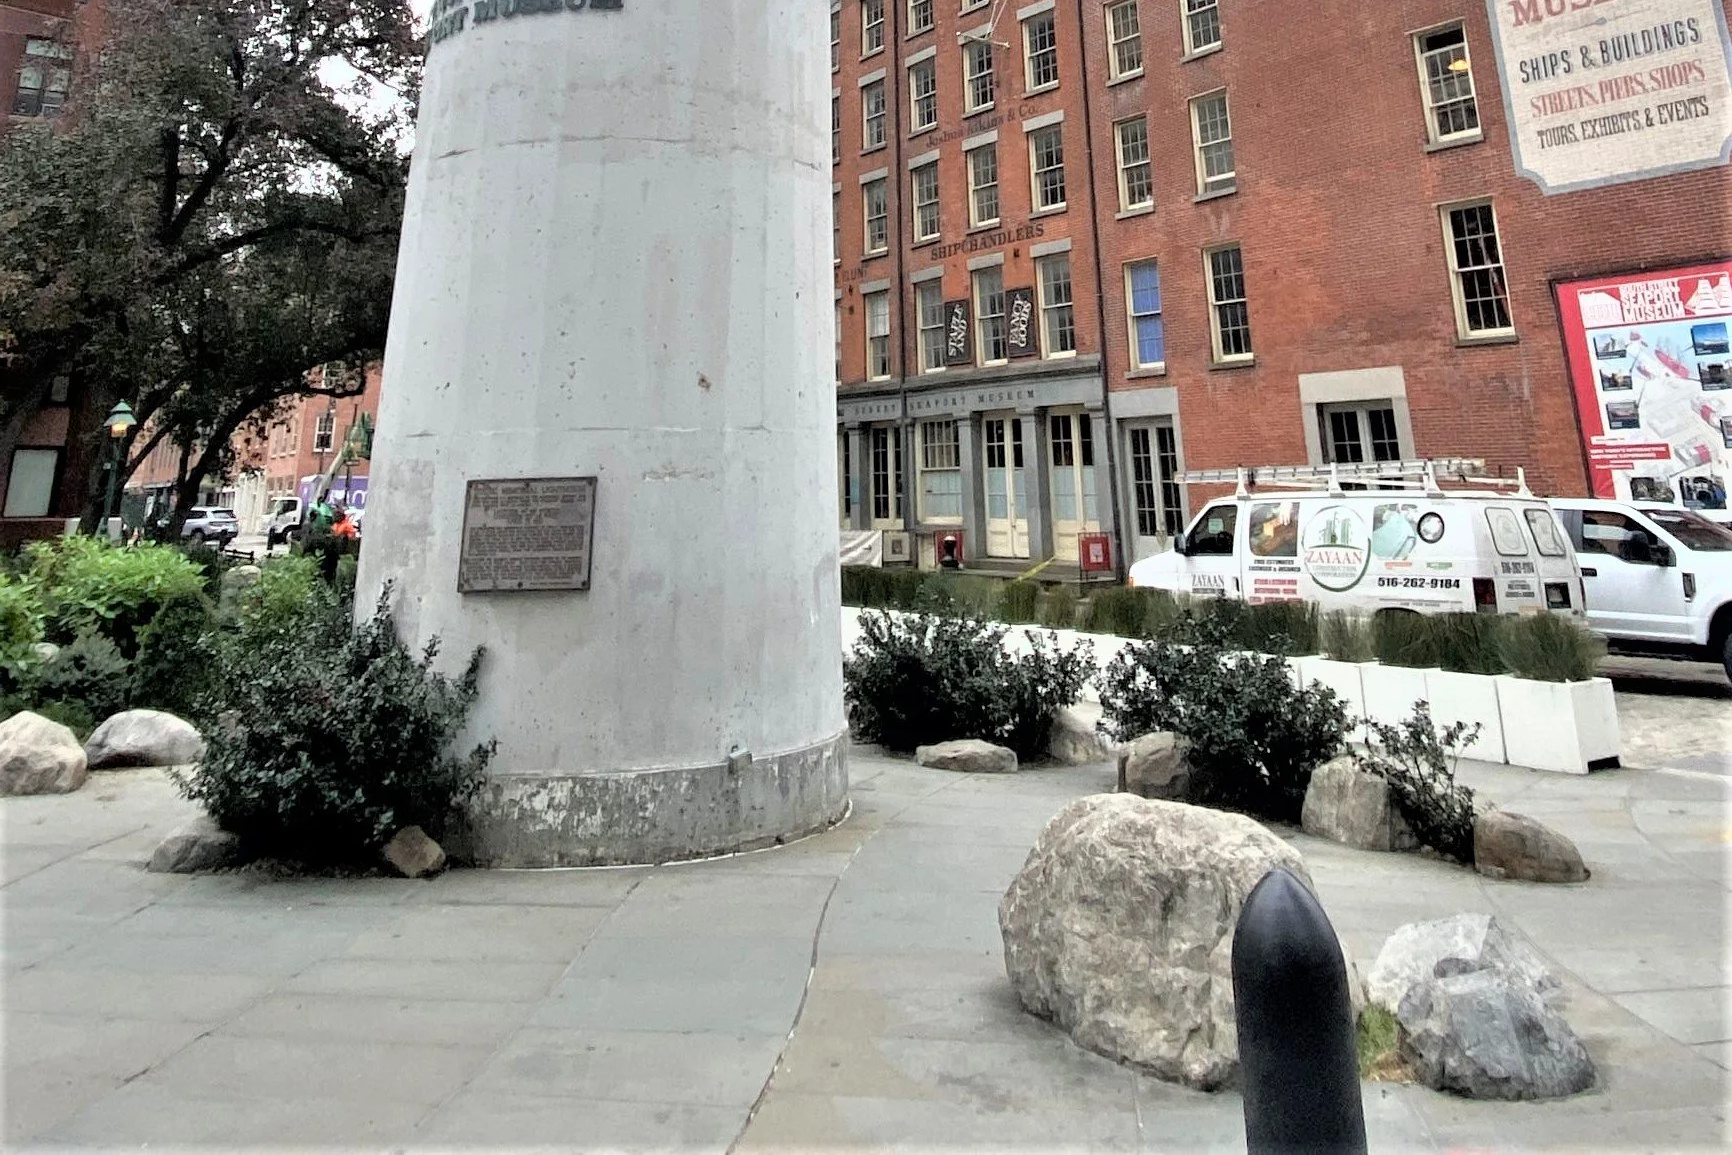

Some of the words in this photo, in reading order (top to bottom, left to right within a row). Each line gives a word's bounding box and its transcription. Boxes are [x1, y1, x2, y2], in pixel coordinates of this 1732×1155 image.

[1519, 50, 1572, 84] SHIPS
[1579, 45, 1596, 69] &
[1598, 17, 1701, 65] BUILDINGS
[1650, 59, 1706, 92] SHOPS
[1644, 108, 1655, 128] &
[1657, 95, 1710, 125] EVENTS
[1620, 288, 1680, 308] SEAPORT
[1622, 301, 1685, 322] MUSEUM
[1019, 300, 1032, 347] GOODS
[978, 389, 1035, 404] MUSEUM
[1306, 550, 1362, 565] ZAYAAN
